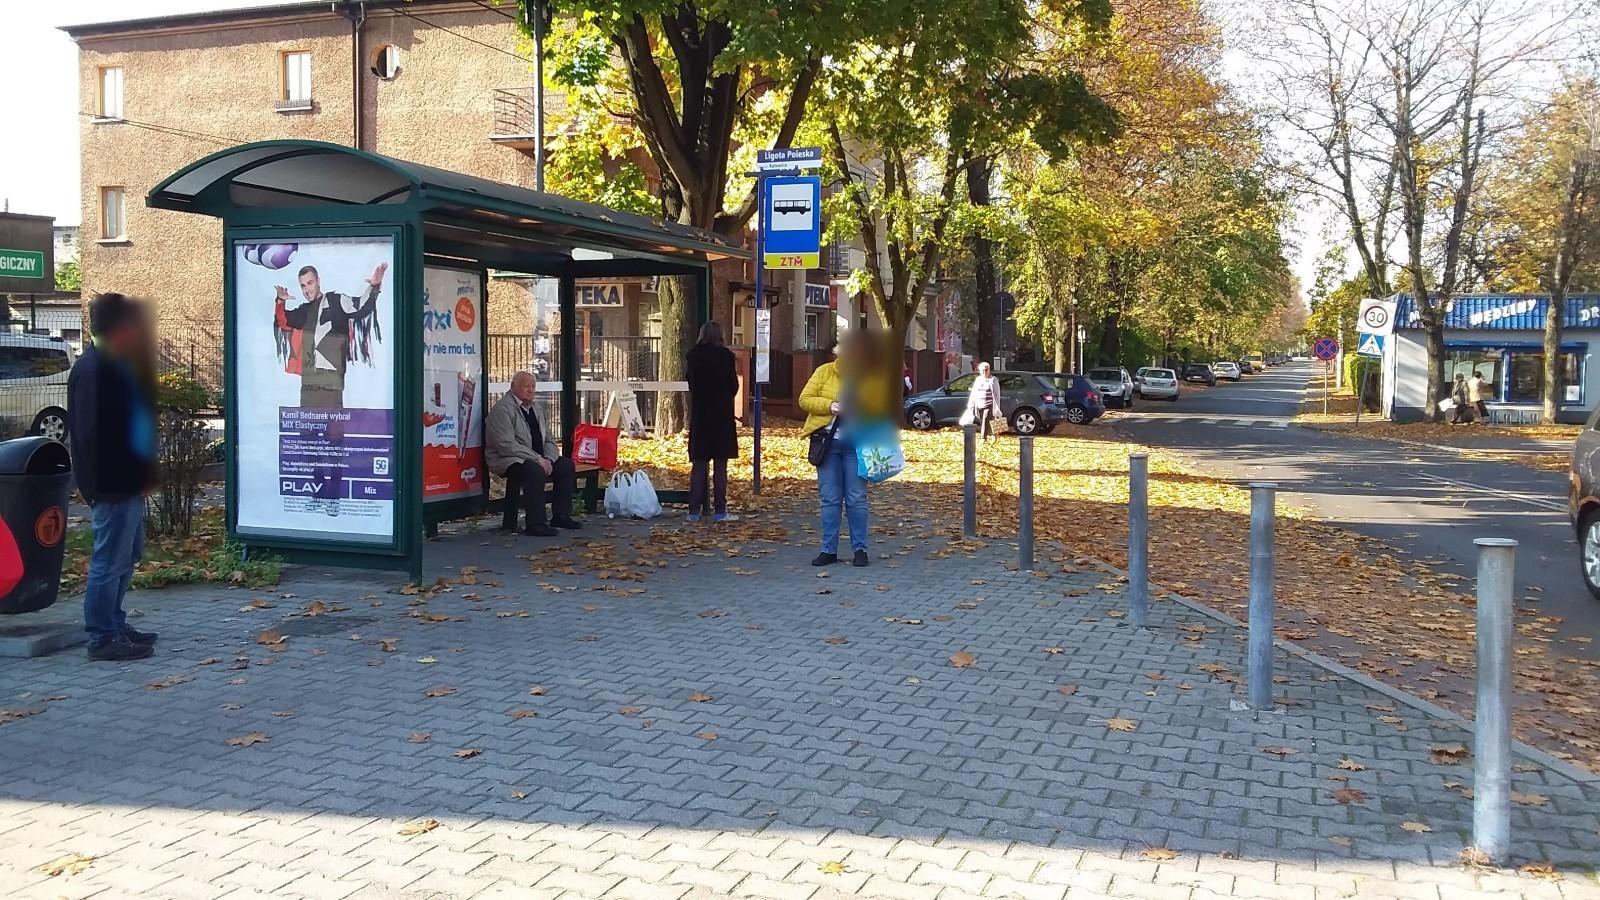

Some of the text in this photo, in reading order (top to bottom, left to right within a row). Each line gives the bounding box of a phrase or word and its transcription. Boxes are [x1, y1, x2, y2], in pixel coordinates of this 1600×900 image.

[764, 149, 814, 161] Ligota Poleska
[780, 256, 803, 266] ZTM
[1368, 312, 1385, 323] 30
[1470, 299, 1536, 325] WĘDLINY
[1581, 306, 1600, 321] DR
[433, 342, 447, 354] nie
[449, 344, 462, 354] ma
[282, 411, 351, 422] Kamil Bednarek wybrał
[282, 421, 327, 431] MIX Elastyczny
[375, 459, 387, 470] 5G
[282, 481, 323, 493] PLAY
[364, 486, 377, 495] Mix
